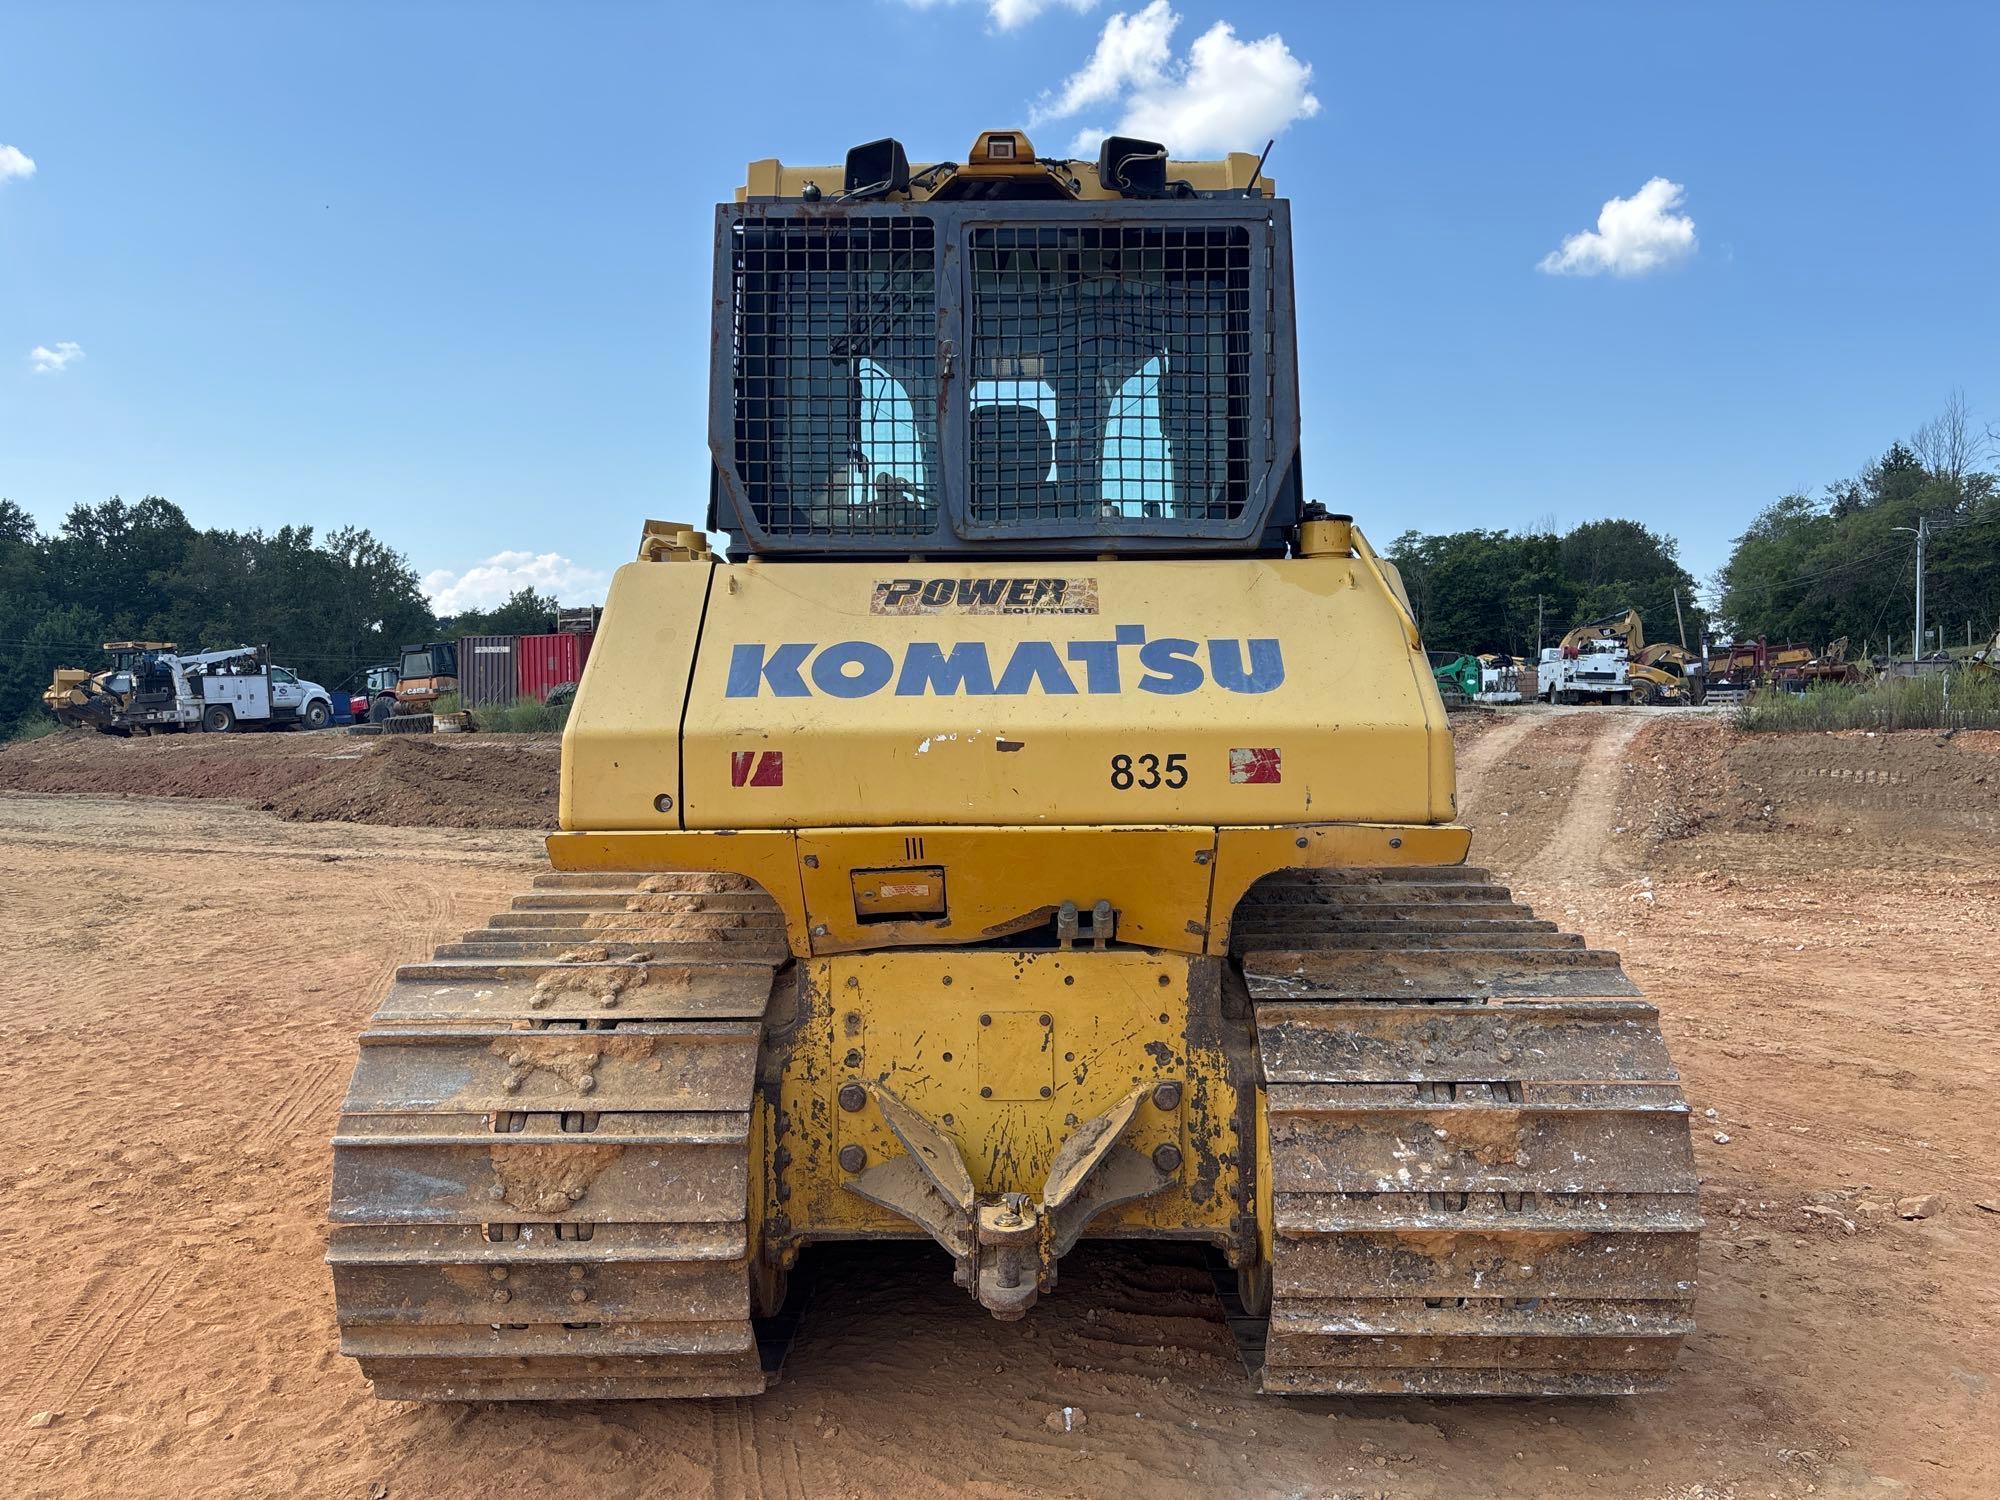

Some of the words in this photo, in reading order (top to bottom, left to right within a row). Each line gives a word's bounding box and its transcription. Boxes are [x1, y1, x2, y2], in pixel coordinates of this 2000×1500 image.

[876, 578, 1069, 608] POWER
[725, 624, 1285, 699] KOMATSU
[1110, 753, 1188, 791] 835
